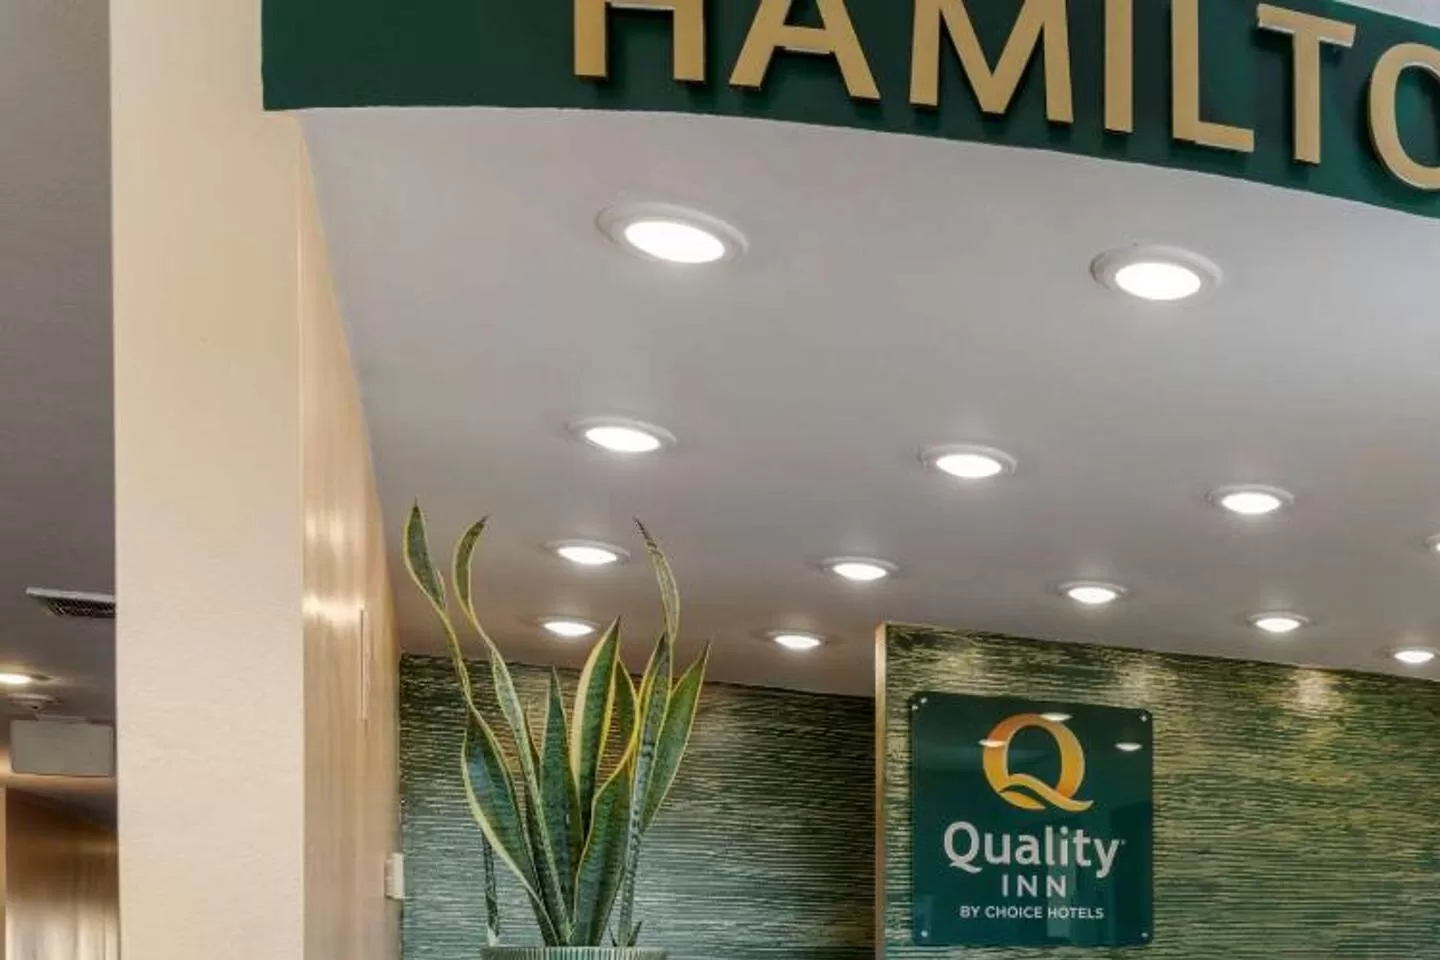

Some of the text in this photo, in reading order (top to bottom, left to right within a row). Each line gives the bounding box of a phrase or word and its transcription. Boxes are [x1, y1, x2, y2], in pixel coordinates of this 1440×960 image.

[943, 820, 1121, 879] Quality
[1001, 873, 1067, 899] INN
[958, 904, 1105, 920] BY CHOICE HOTELS
